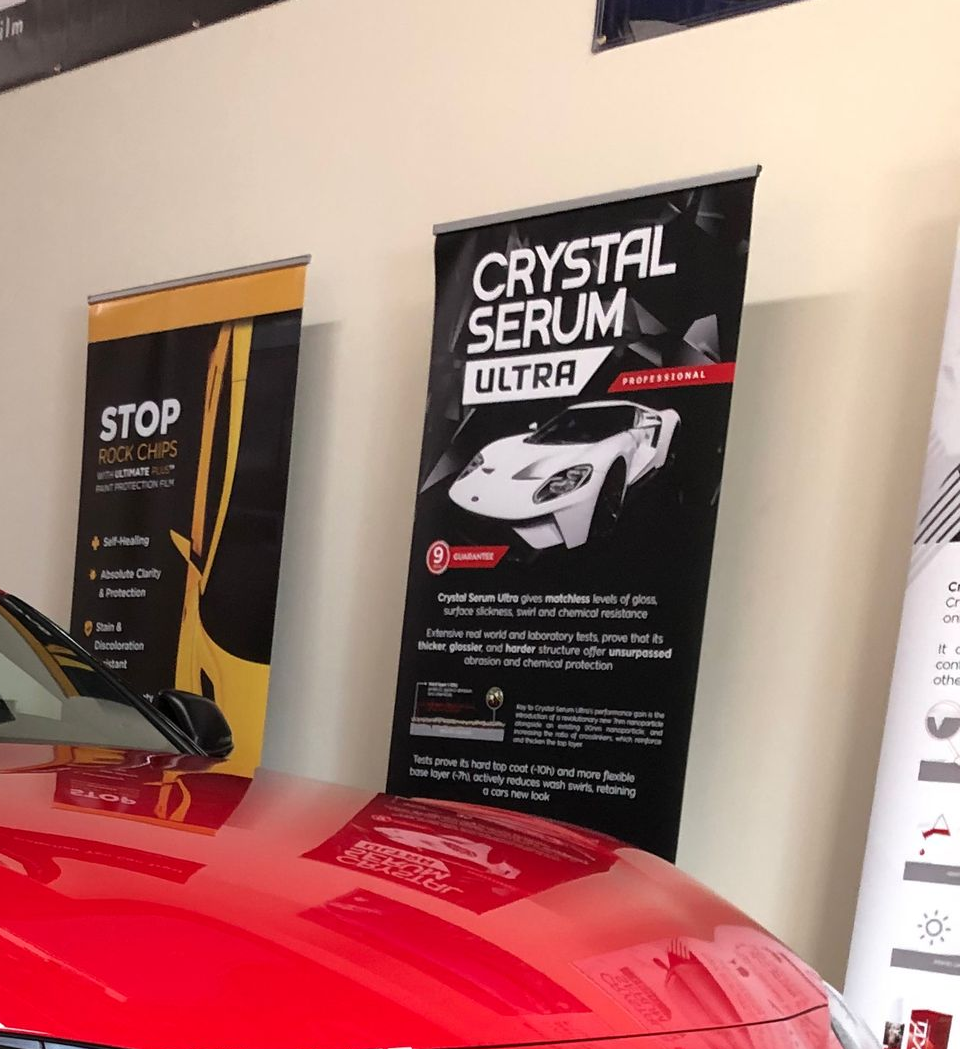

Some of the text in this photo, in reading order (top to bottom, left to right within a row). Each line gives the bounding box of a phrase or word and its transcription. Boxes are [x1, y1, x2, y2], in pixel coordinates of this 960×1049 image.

[472, 224, 677, 301] CRYSTAL
[466, 288, 628, 355] SERUM
[475, 359, 577, 395] ULTRA
[622, 370, 706, 386] PROFESSIONAL
[99, 398, 181, 442] STOP
[98, 440, 178, 465] ROCK CHIPS
[114, 466, 150, 479] ULTIMATE
[96, 479, 175, 493] PAINT PROTECTION FILM
[103, 534, 150, 547] Self-Healing
[433, 546, 444, 564] 9
[453, 552, 494, 561] GUARANTEE
[101, 568, 162, 580] Absolute Clarity
[99, 587, 146, 598] & Protection
[437, 592, 467, 604] Crystal
[469, 593, 496, 603] Serum
[498, 593, 519, 603] Ultra
[521, 594, 542, 605] gives
[545, 594, 591, 604] matchless
[592, 594, 618, 605] levels
[619, 593, 631, 606] of
[443, 605, 474, 618] surface
[516, 607, 536, 617] swirl
[537, 607, 556, 617] and
[558, 608, 599, 618] chemical
[600, 609, 648, 620] resistance
[96, 621, 122, 632] Stain &
[426, 628, 464, 638] Extensive
[465, 629, 482, 639] real
[483, 629, 507, 640] world
[508, 630, 526, 640] and
[527, 630, 574, 643] laboratory
[601, 633, 628, 644] prove
[630, 633, 650, 644] that
[652, 633, 664, 644] its
[94, 641, 145, 650] Discoloration
[485, 643, 504, 653] and
[505, 643, 536, 654] harder
[538, 645, 580, 655] structure
[582, 646, 607, 658] offer
[608, 648, 673, 660] unsurpassed
[463, 656, 613, 671] abrasion and chemical protection
[413, 754, 433, 765] Tests
[434, 757, 458, 768] prove
[459, 758, 469, 768] its
[471, 759, 491, 770] hard
[492, 760, 507, 773] top
[509, 764, 529, 773] coat
[557, 767, 575, 777] and
[577, 770, 601, 780] more
[603, 769, 635, 782] flexible
[409, 767, 428, 777] base
[430, 768, 450, 780] layer
[473, 773, 505, 786] actively
[506, 776, 540, 787] reduces
[543, 780, 566, 790] wash
[596, 784, 637, 799] retaining
[483, 788, 551, 802] a cars new look
